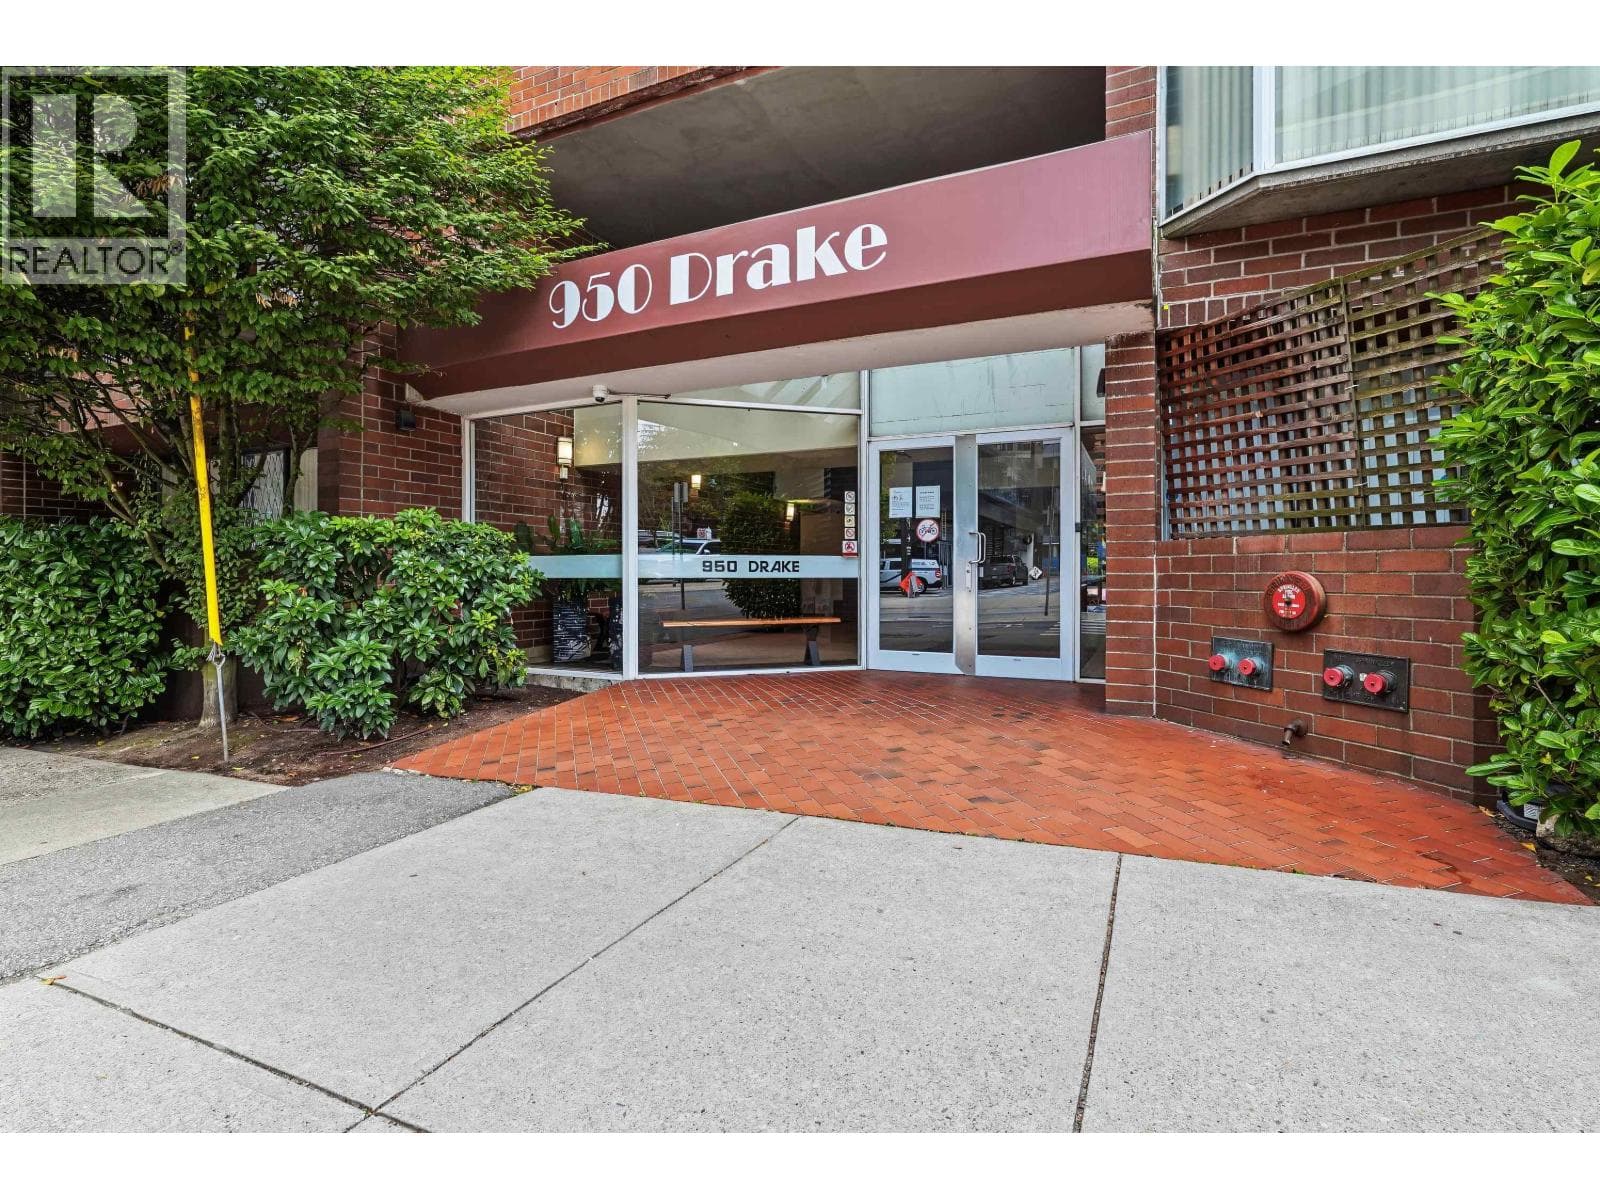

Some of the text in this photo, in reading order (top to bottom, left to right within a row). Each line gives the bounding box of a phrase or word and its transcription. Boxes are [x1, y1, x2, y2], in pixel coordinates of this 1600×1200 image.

[549, 223, 888, 329] 950 Drake
[702, 560, 800, 573] 950 DRAKE
